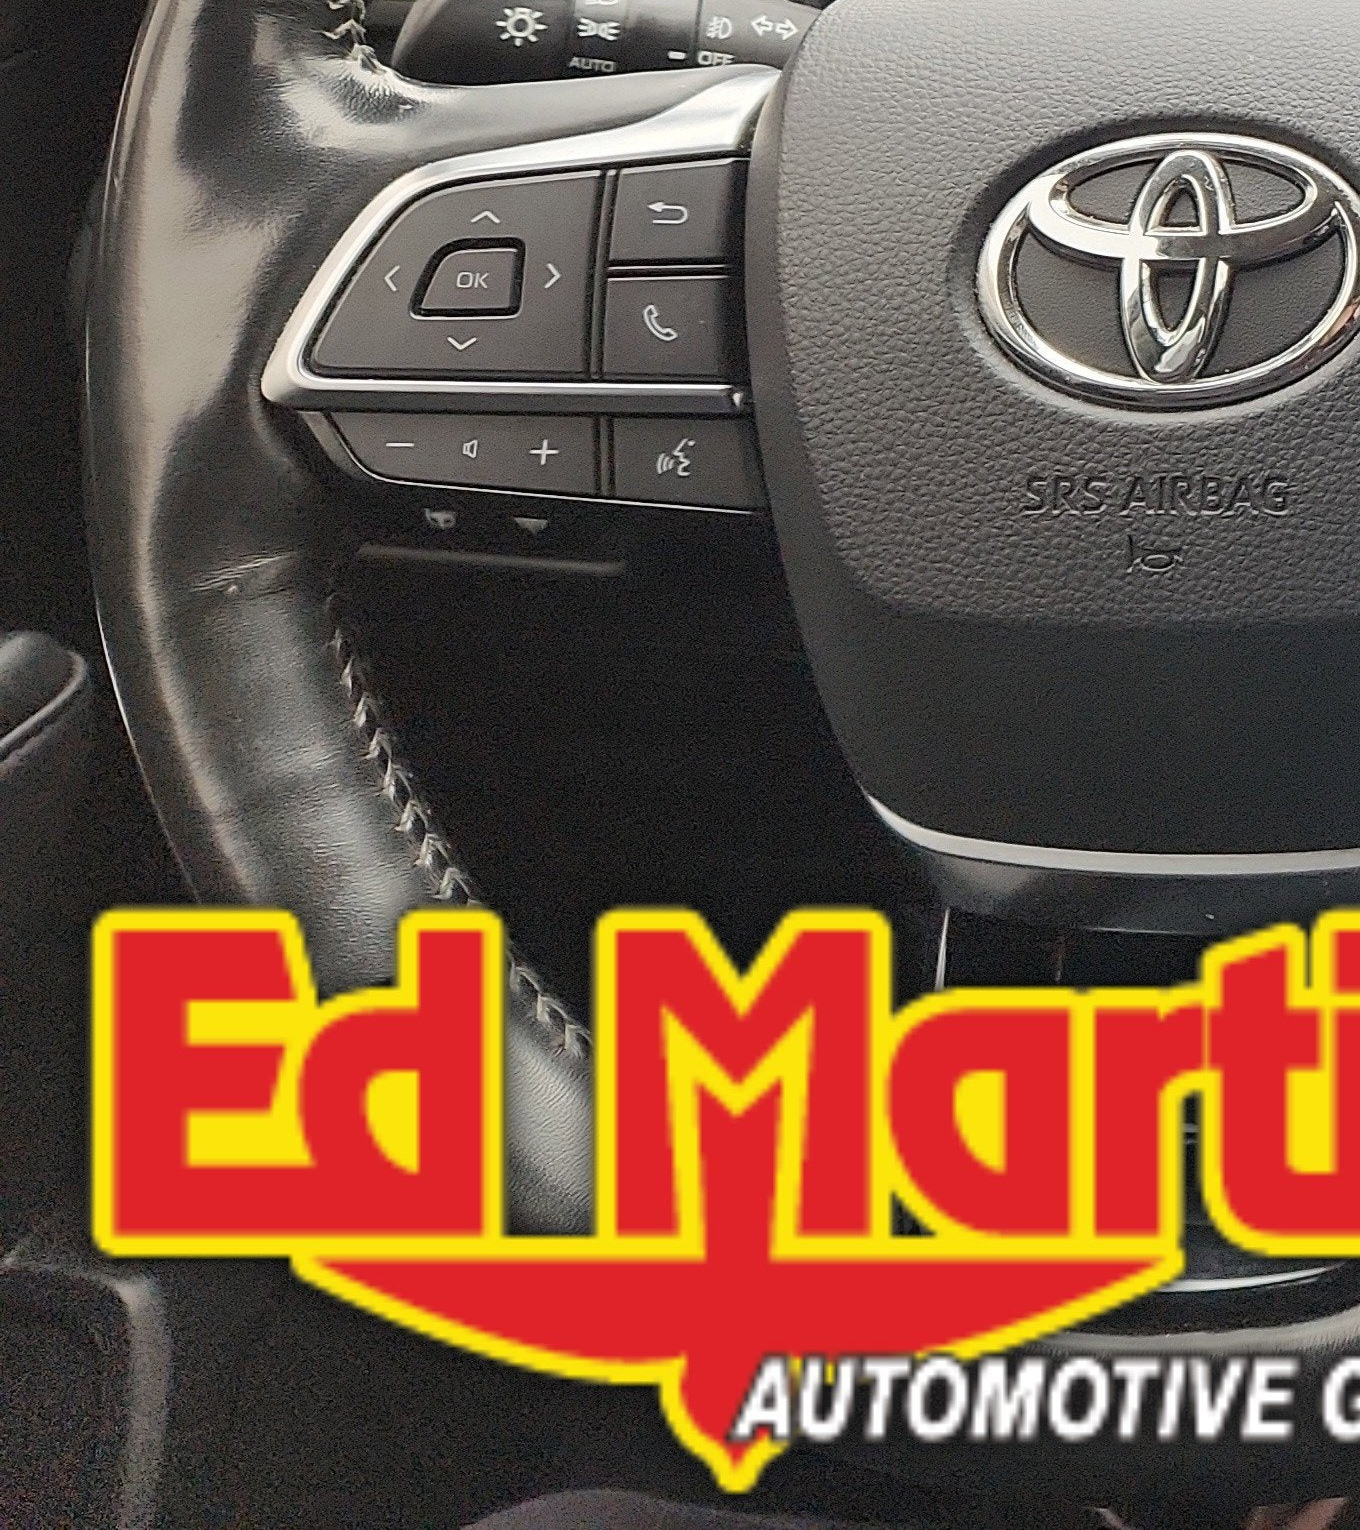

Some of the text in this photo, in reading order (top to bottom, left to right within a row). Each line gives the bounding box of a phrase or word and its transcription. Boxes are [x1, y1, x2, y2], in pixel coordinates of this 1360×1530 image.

[568, 56, 618, 72] AUTO
[698, 50, 736, 67] OFF
[456, 271, 489, 290] OK
[1022, 473, 1290, 516] SRS AIRBAG
